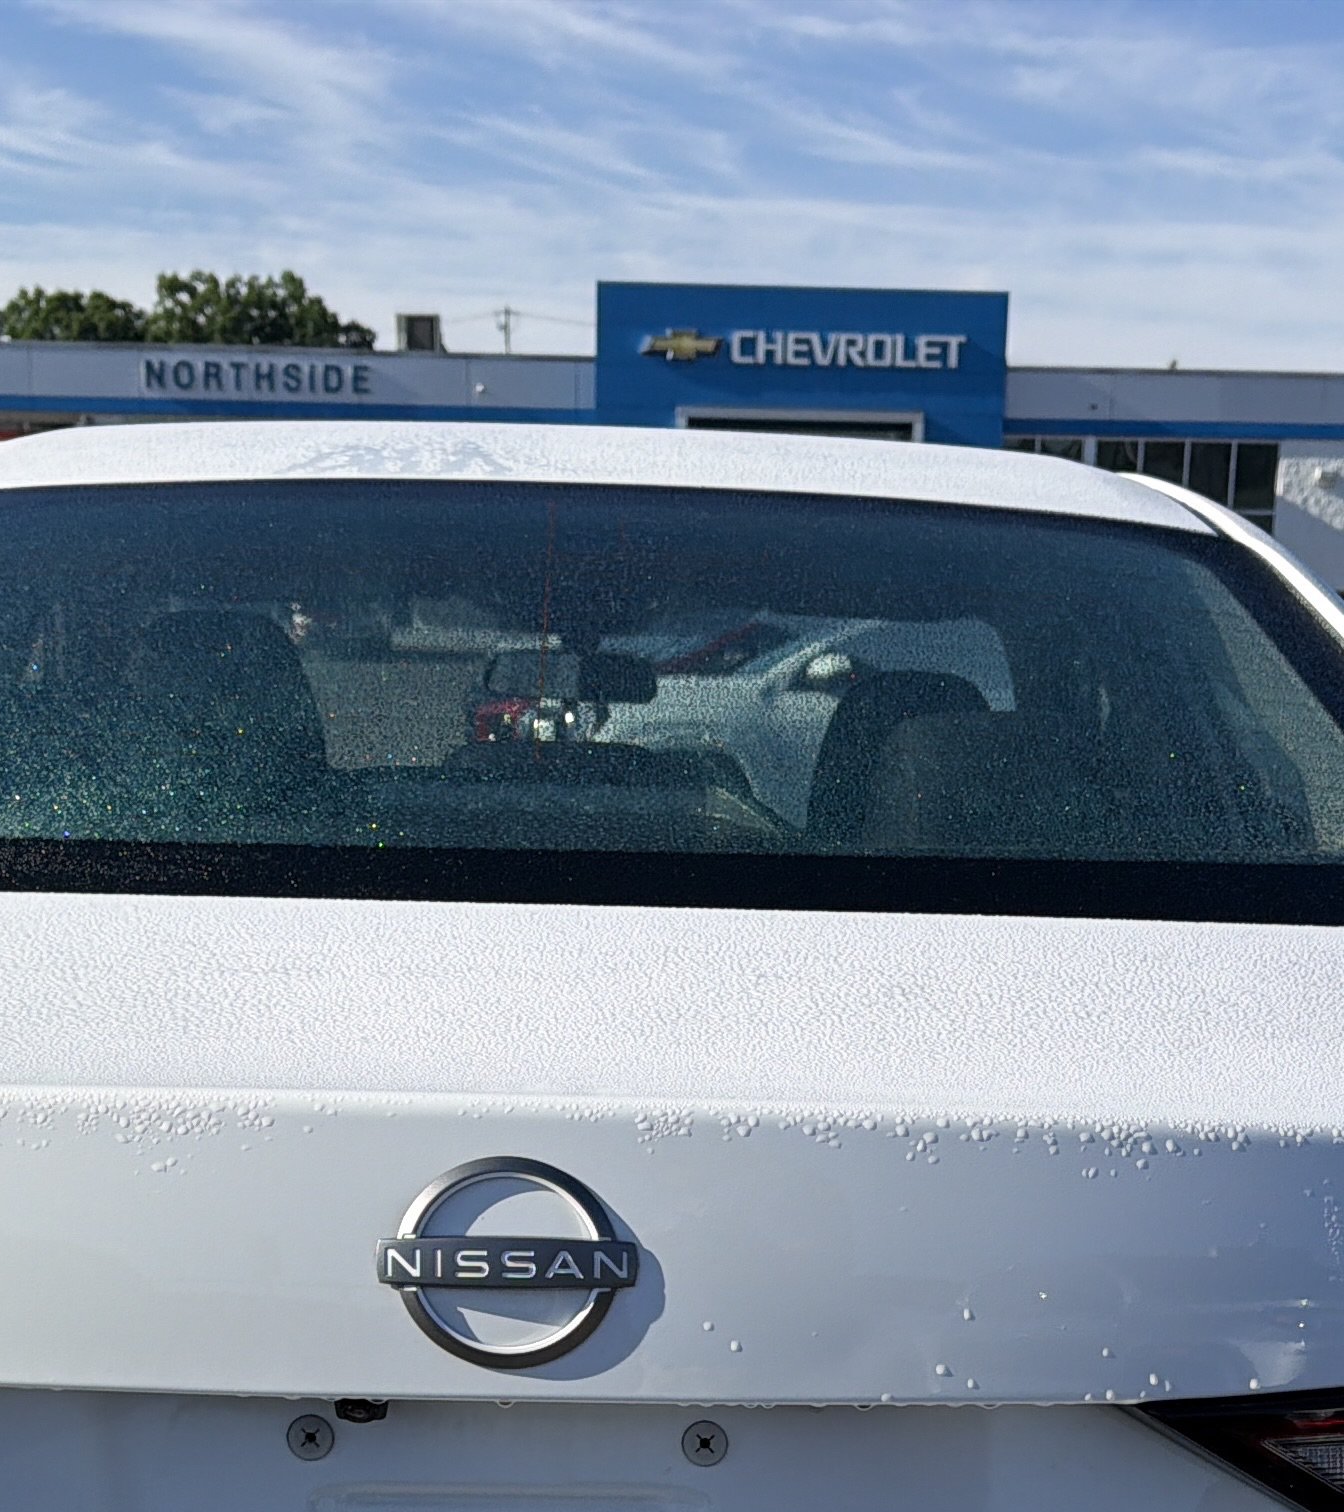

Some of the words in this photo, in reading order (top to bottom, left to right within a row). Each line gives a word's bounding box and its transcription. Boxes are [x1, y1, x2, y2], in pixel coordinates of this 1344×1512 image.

[729, 328, 967, 369] CHEVROLET
[143, 359, 372, 394] NORTHSIDE
[386, 1248, 628, 1280] NISSAN
